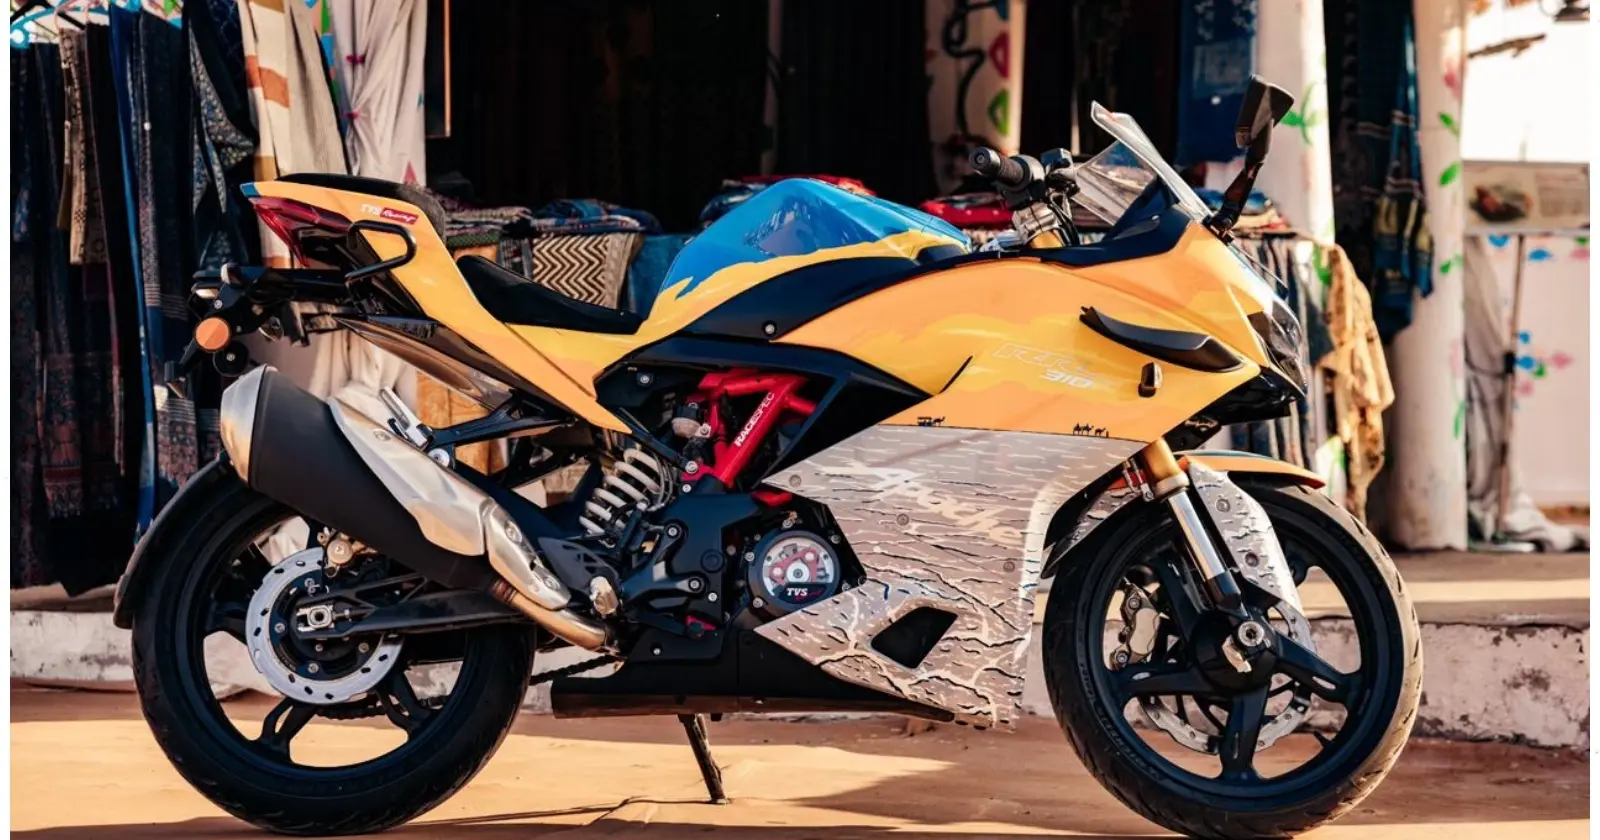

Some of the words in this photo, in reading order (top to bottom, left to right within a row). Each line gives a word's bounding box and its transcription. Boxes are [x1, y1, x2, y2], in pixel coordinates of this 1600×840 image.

[1039, 368, 1094, 389] 310
[820, 462, 1026, 547] Apache
[787, 587, 808, 597] TVS
